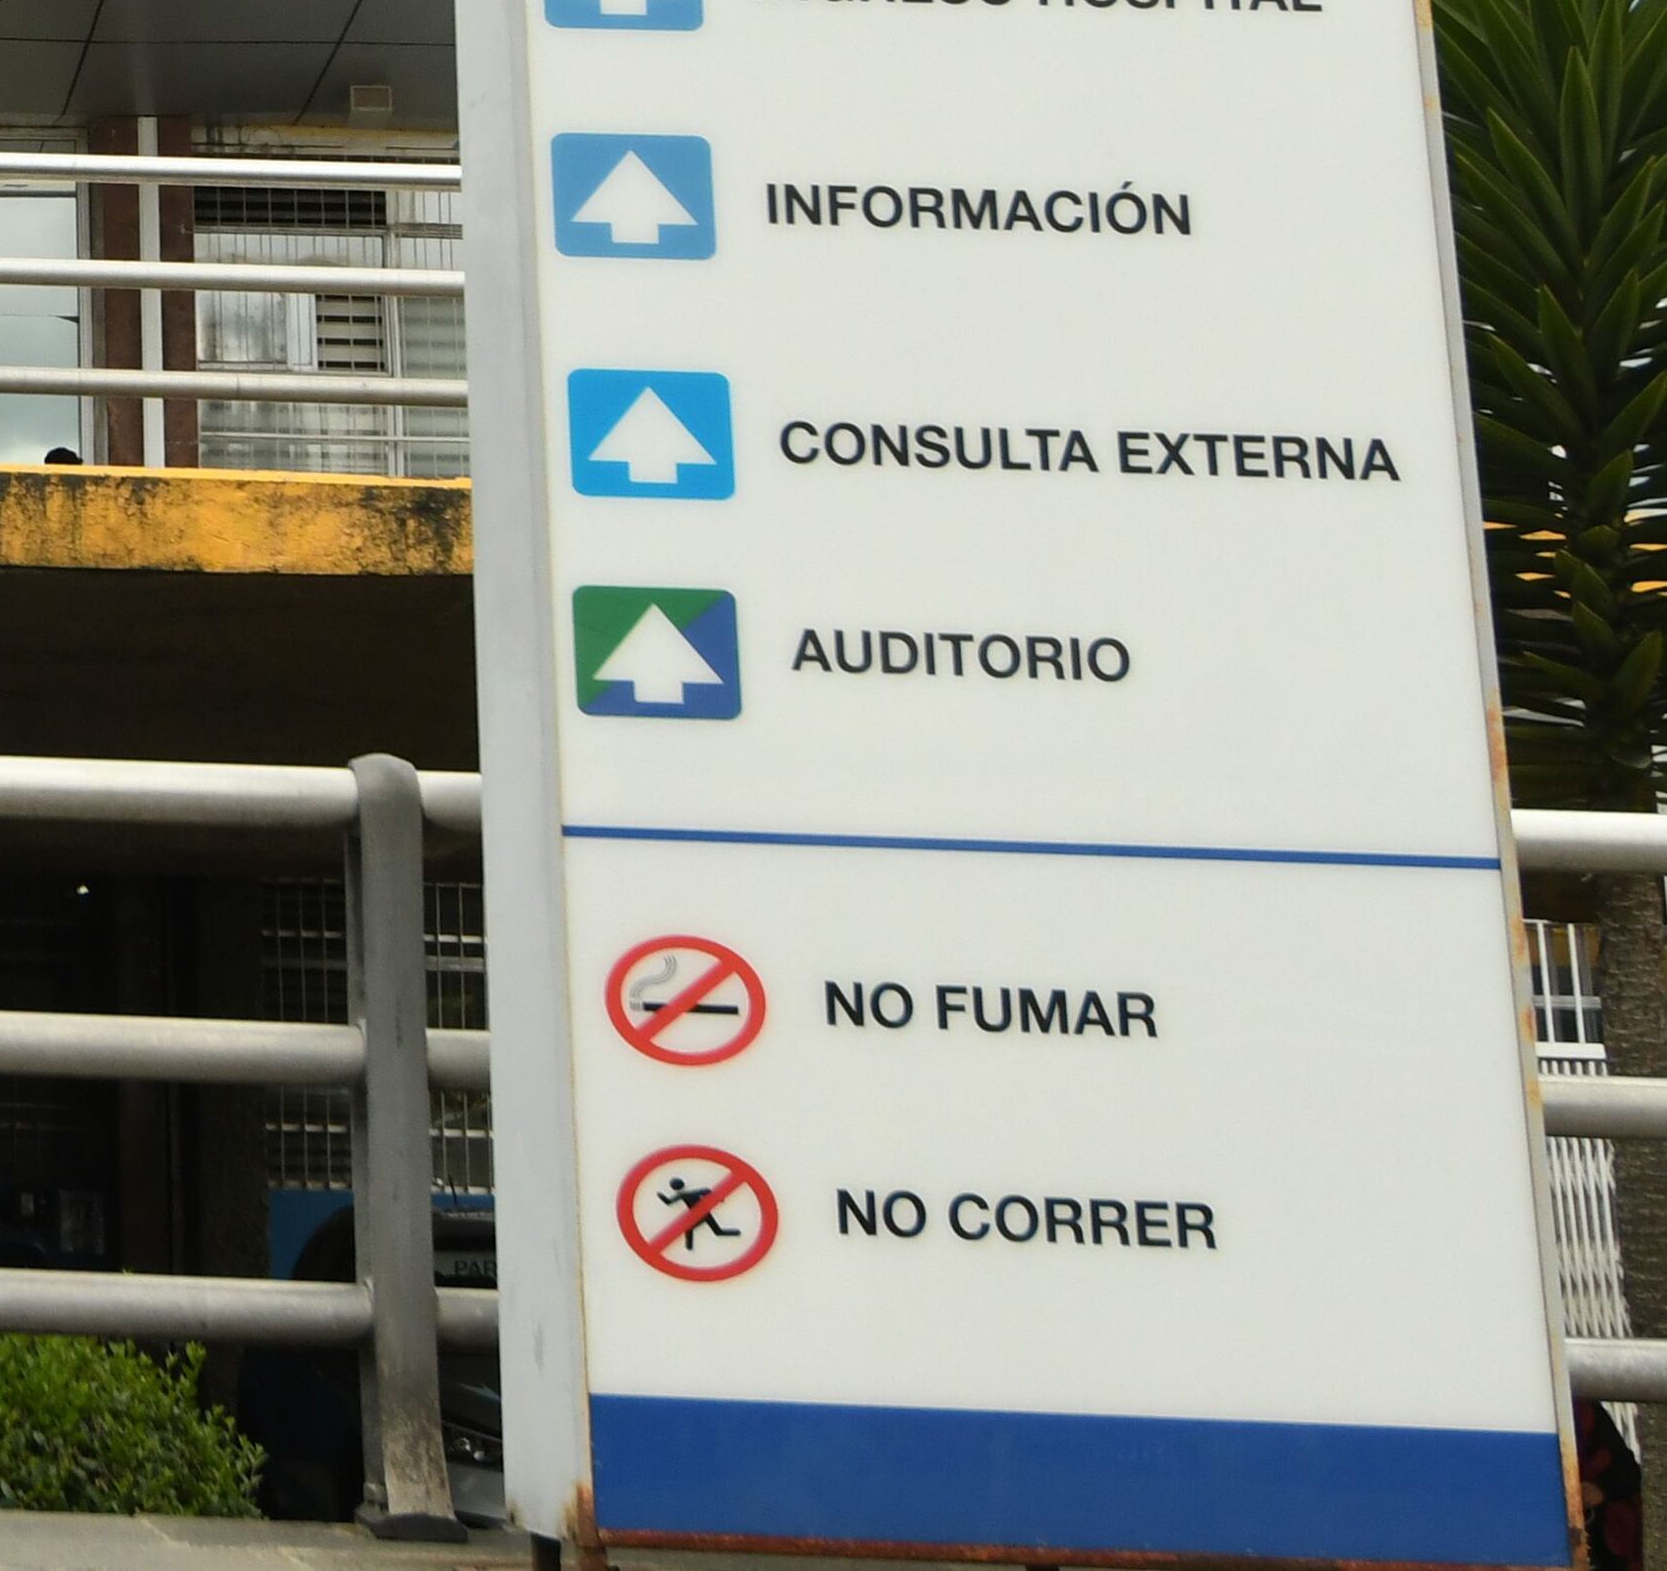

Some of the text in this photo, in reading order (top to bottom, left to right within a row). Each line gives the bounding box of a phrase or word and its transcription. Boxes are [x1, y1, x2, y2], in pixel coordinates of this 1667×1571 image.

[766, 180, 1193, 237] INFORMACIÓN
[779, 420, 1403, 483] CONSULTA EXTERNA
[791, 628, 1132, 684] AUDITORIO
[824, 980, 1159, 1039] NO FUMAR
[836, 1188, 1219, 1251] NO CORRER
